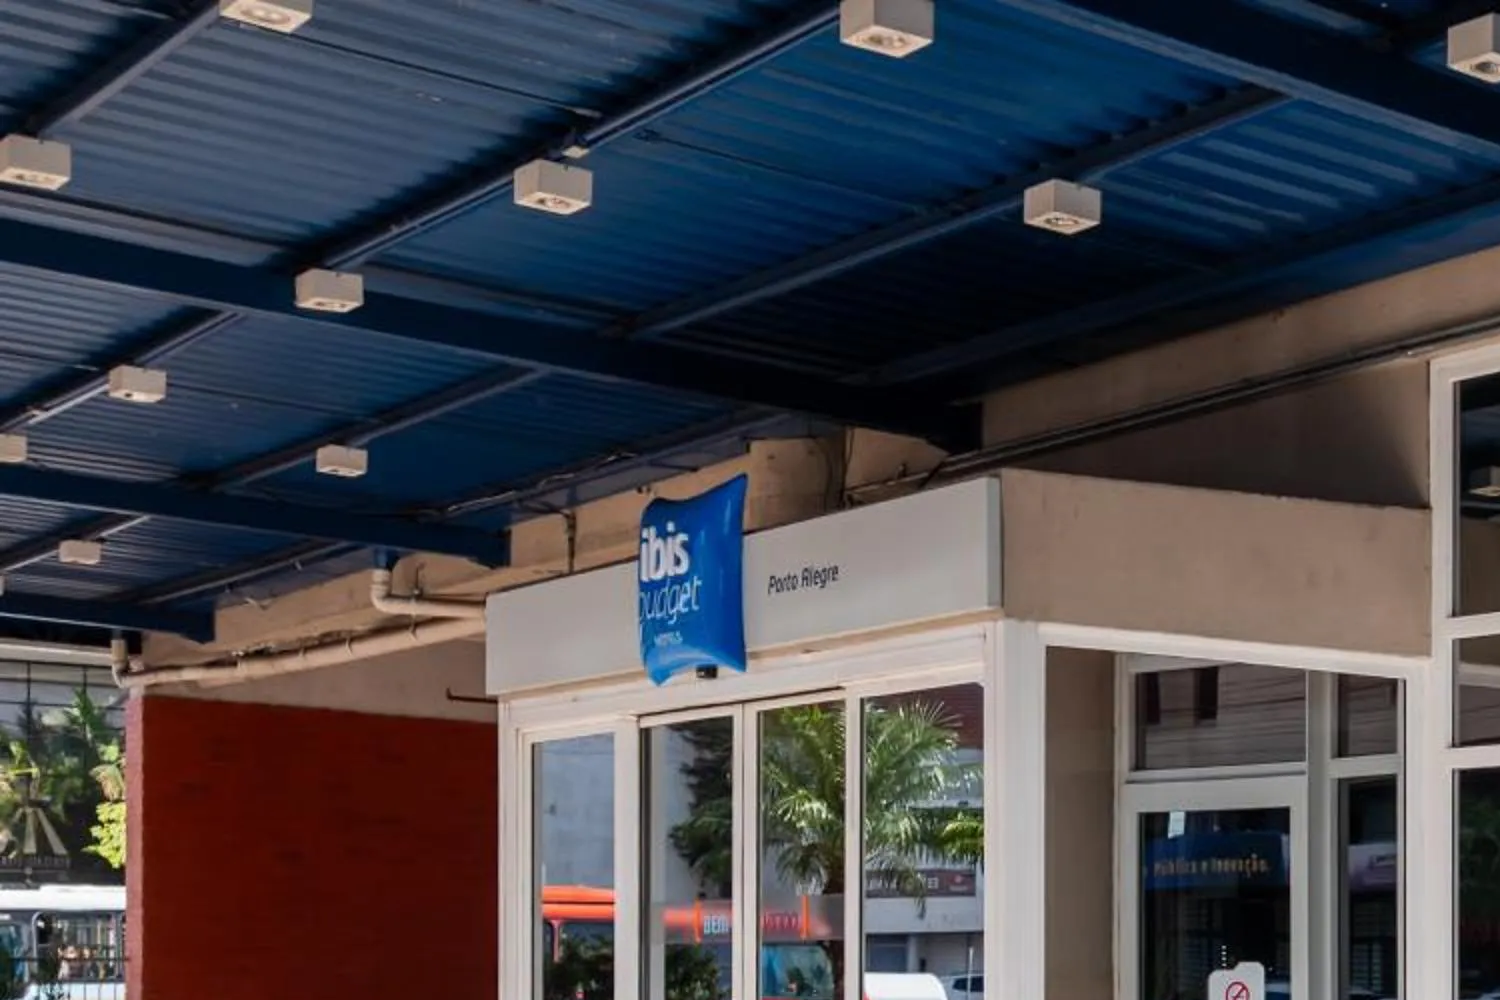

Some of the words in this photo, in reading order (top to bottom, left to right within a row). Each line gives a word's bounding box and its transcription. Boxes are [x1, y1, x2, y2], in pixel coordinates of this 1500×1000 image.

[639, 521, 690, 583] ibis
[767, 573, 799, 596] Porto
[801, 565, 839, 589] Alegre
